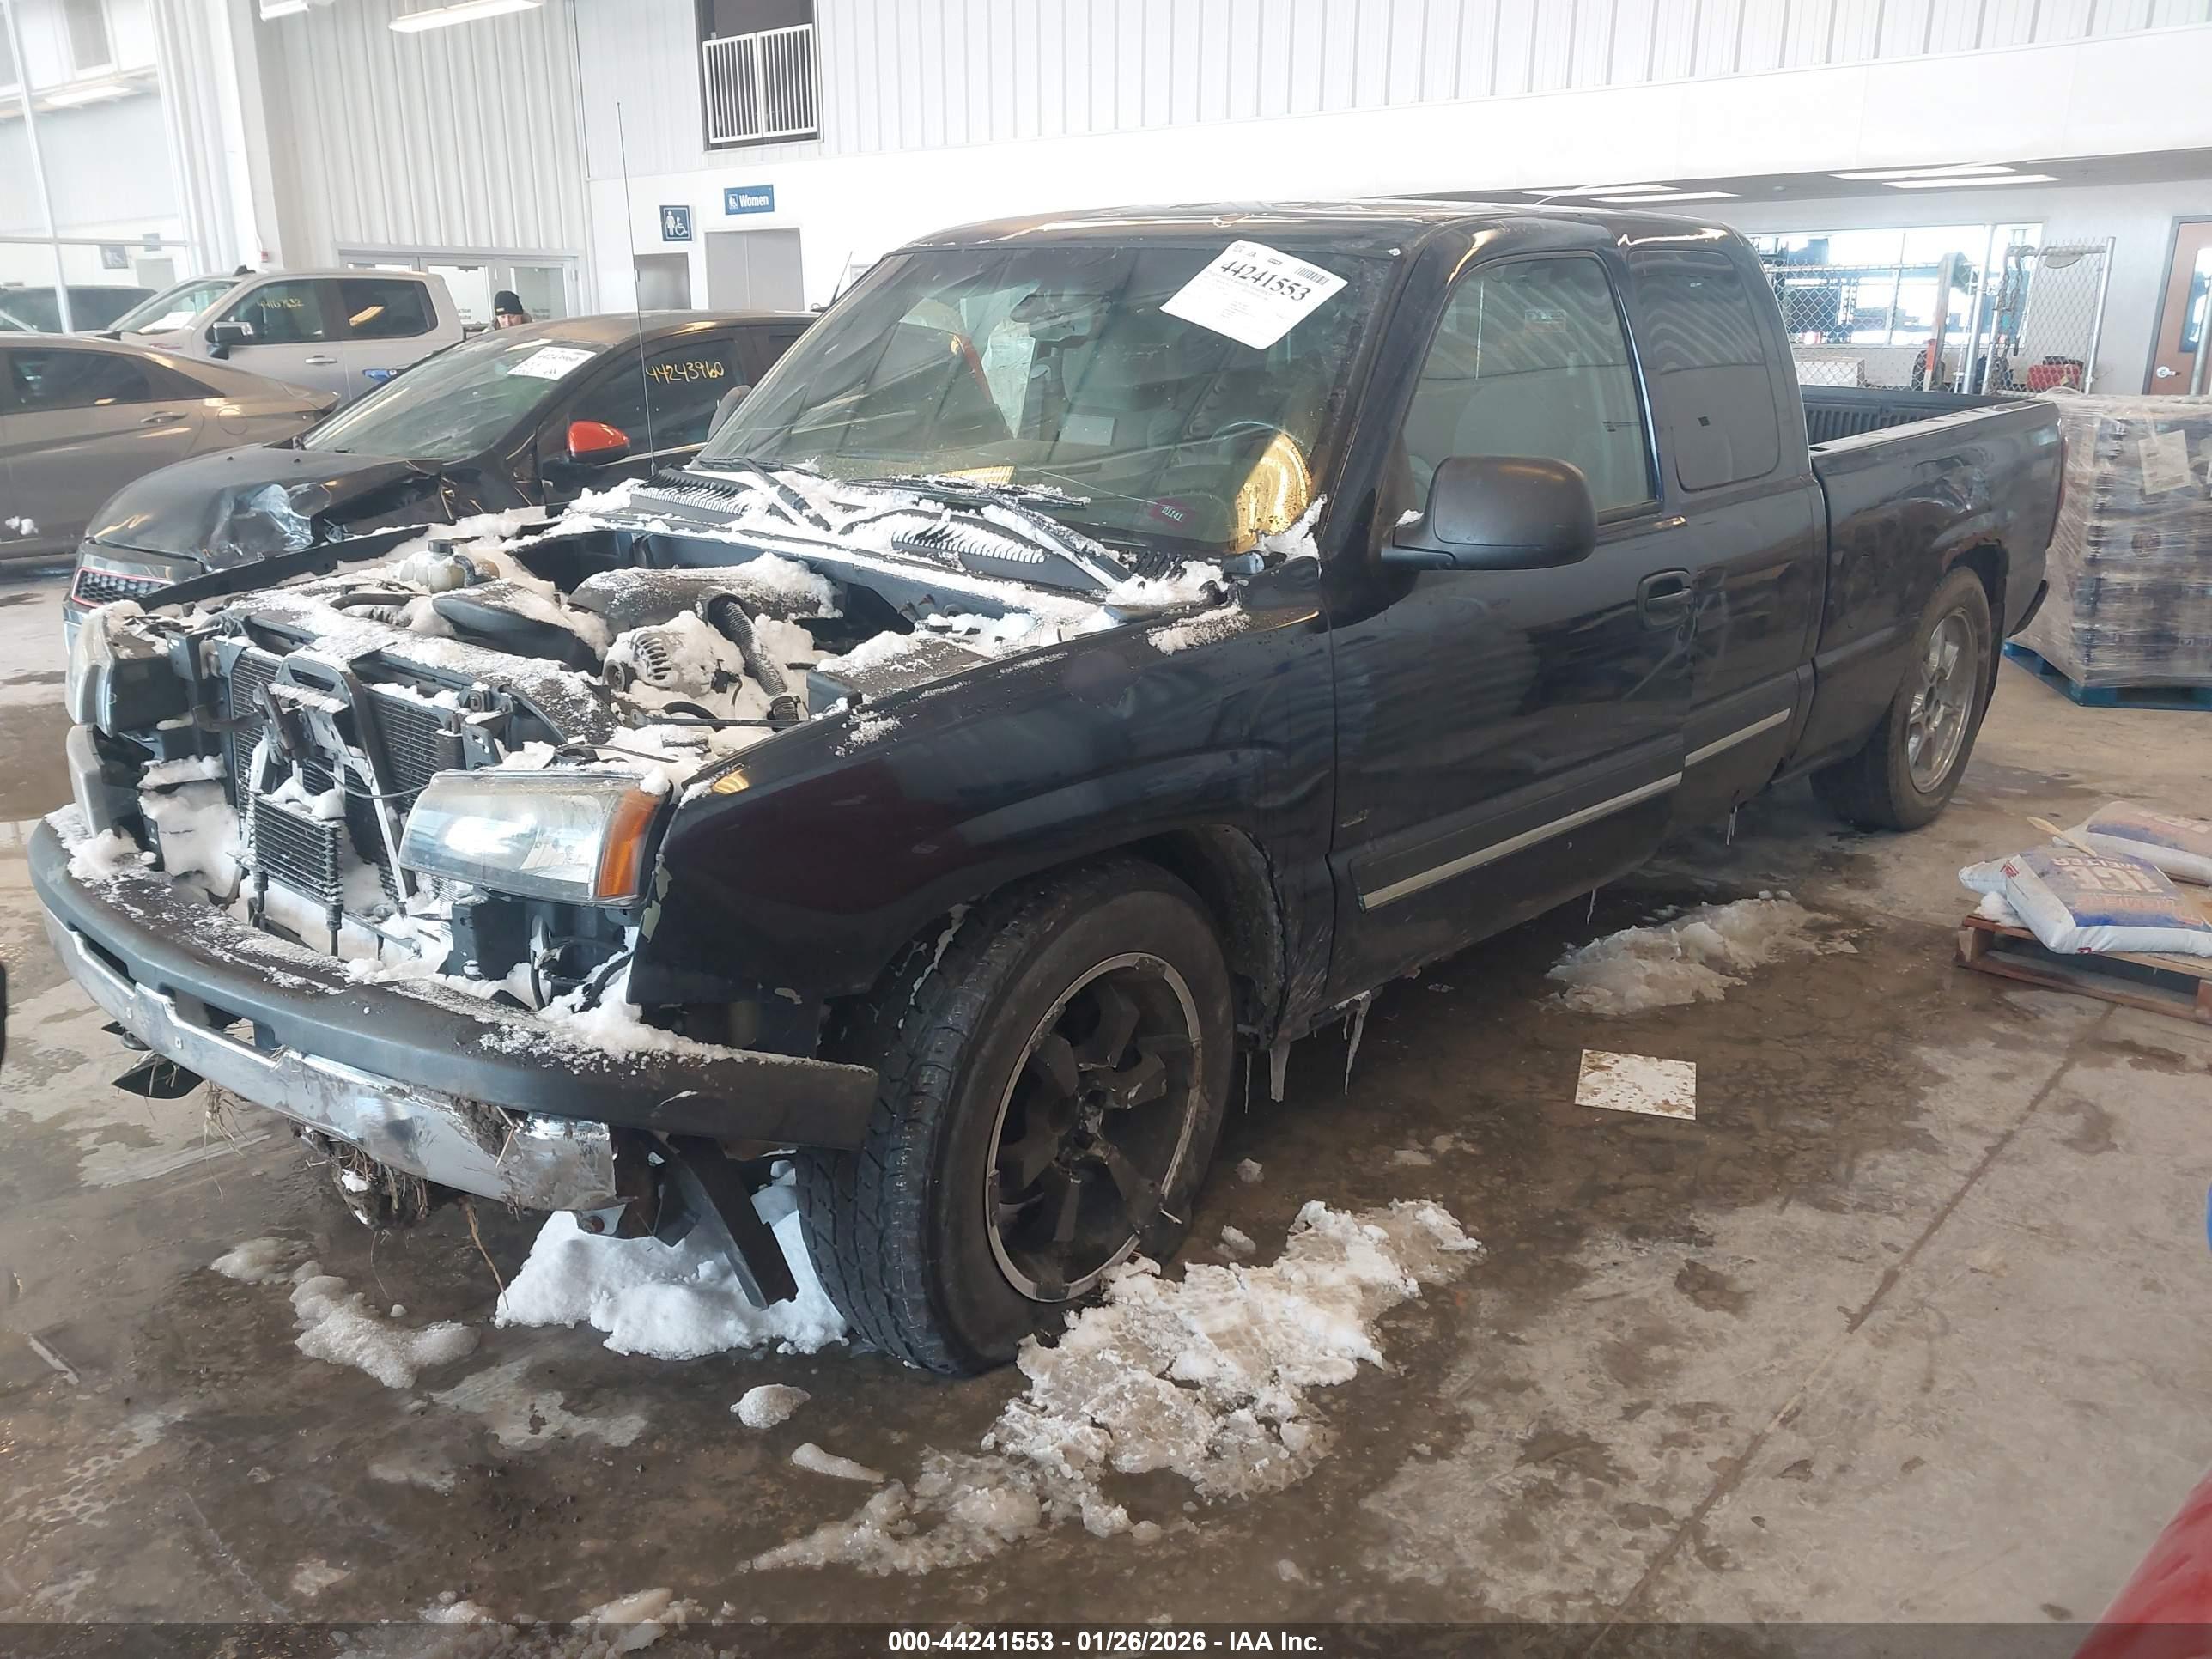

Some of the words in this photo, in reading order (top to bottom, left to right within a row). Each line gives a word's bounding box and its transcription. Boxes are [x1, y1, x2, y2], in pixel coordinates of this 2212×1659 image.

[738, 194, 769, 208] Women
[1220, 259, 1312, 301] 44241553
[645, 360, 725, 385] 44243960
[2052, 857, 2142, 870] MELTER
[2062, 864, 2165, 894] ICE
